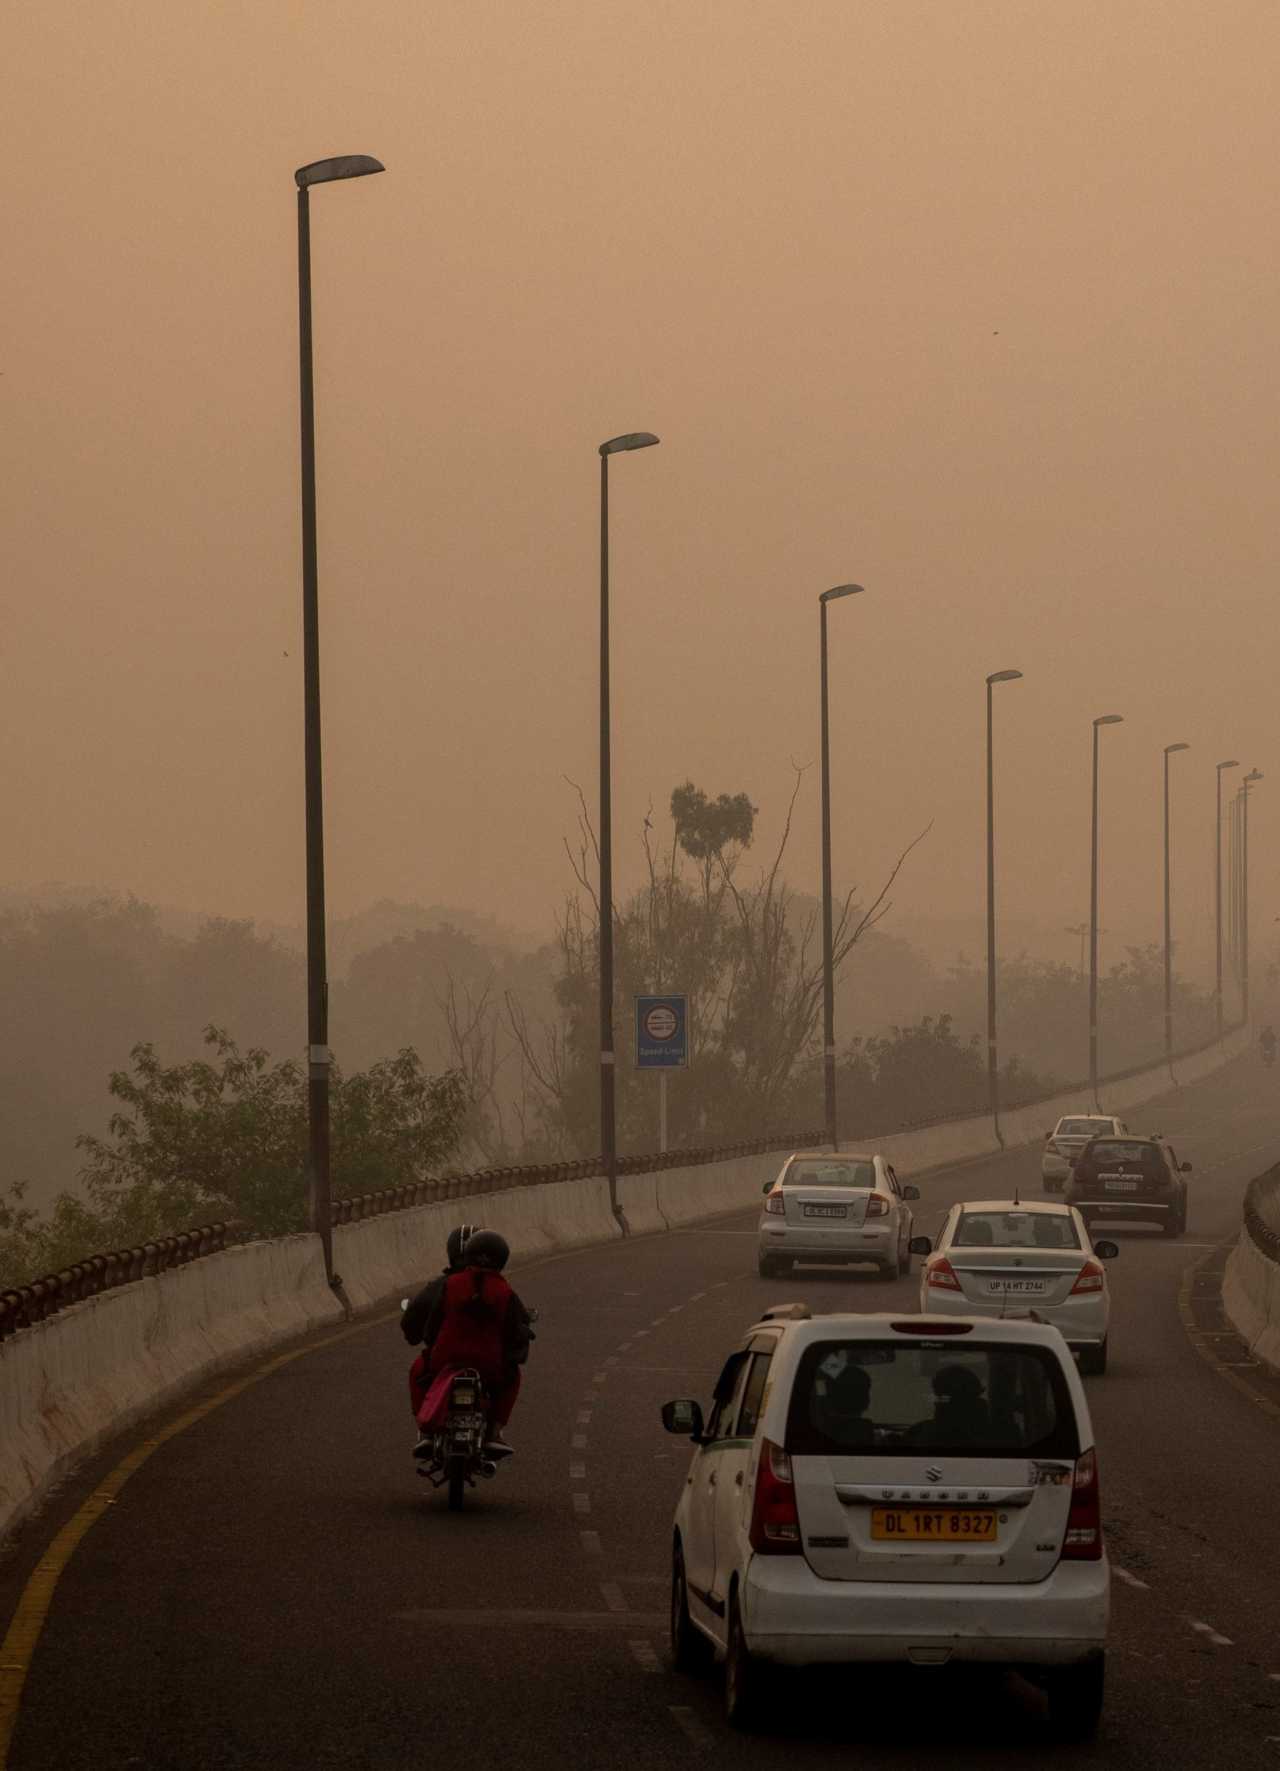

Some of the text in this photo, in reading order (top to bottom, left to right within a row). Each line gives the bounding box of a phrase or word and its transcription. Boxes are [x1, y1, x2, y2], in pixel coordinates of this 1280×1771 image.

[990, 1280, 1000, 1290] UP
[885, 1514, 993, 1534] DL 1RT 8327
